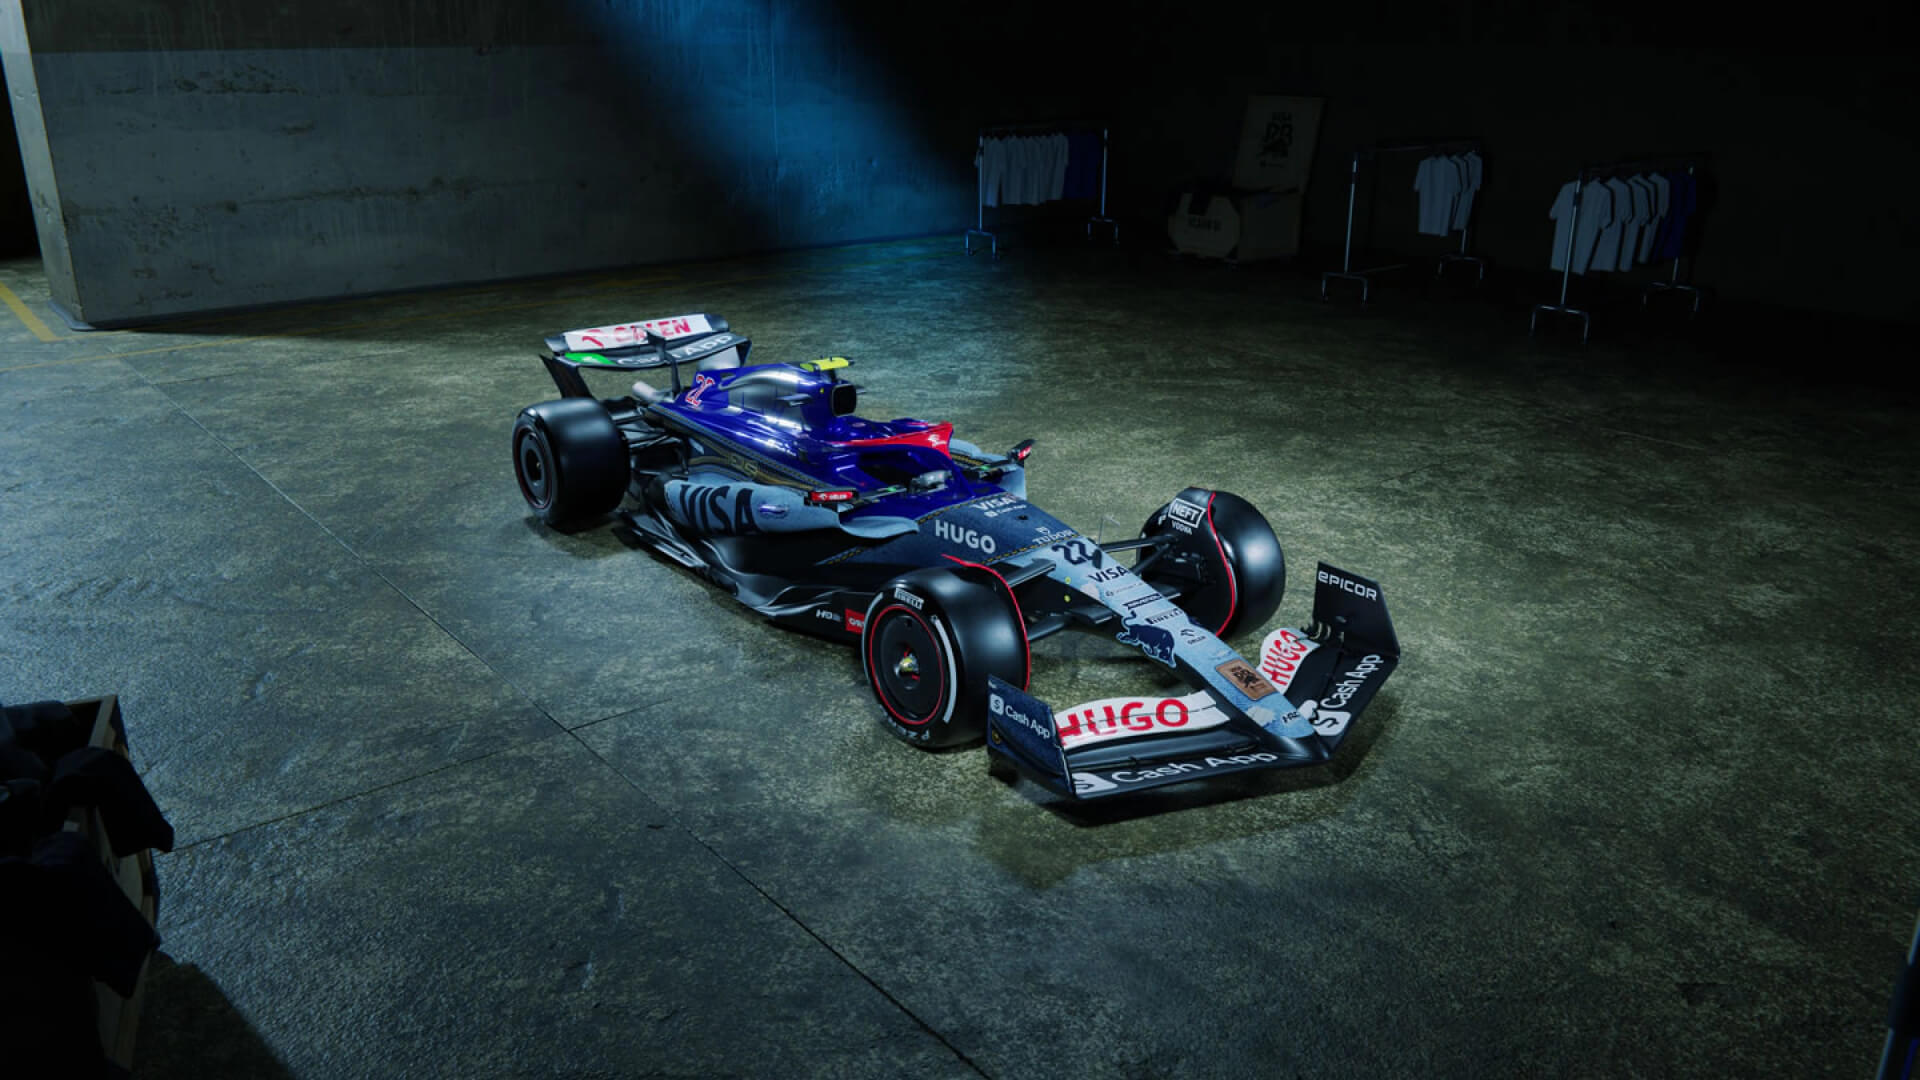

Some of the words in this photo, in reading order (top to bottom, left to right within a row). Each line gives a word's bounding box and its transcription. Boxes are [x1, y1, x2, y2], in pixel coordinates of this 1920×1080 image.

[679, 484, 764, 536] VISA
[1172, 502, 1200, 521] NEFT
[935, 519, 996, 554] HUGO
[1032, 529, 1077, 545] TUDOR
[1088, 565, 1130, 582] VISA
[1262, 629, 1309, 686] HUGO
[1320, 675, 1359, 709] Cash
[1345, 654, 1384, 682] App
[1005, 705, 1030, 728] Cash
[1030, 719, 1051, 740] App
[1056, 698, 1189, 746] HUGO
[1111, 760, 1198, 784] Cash
[1204, 751, 1279, 769] App
